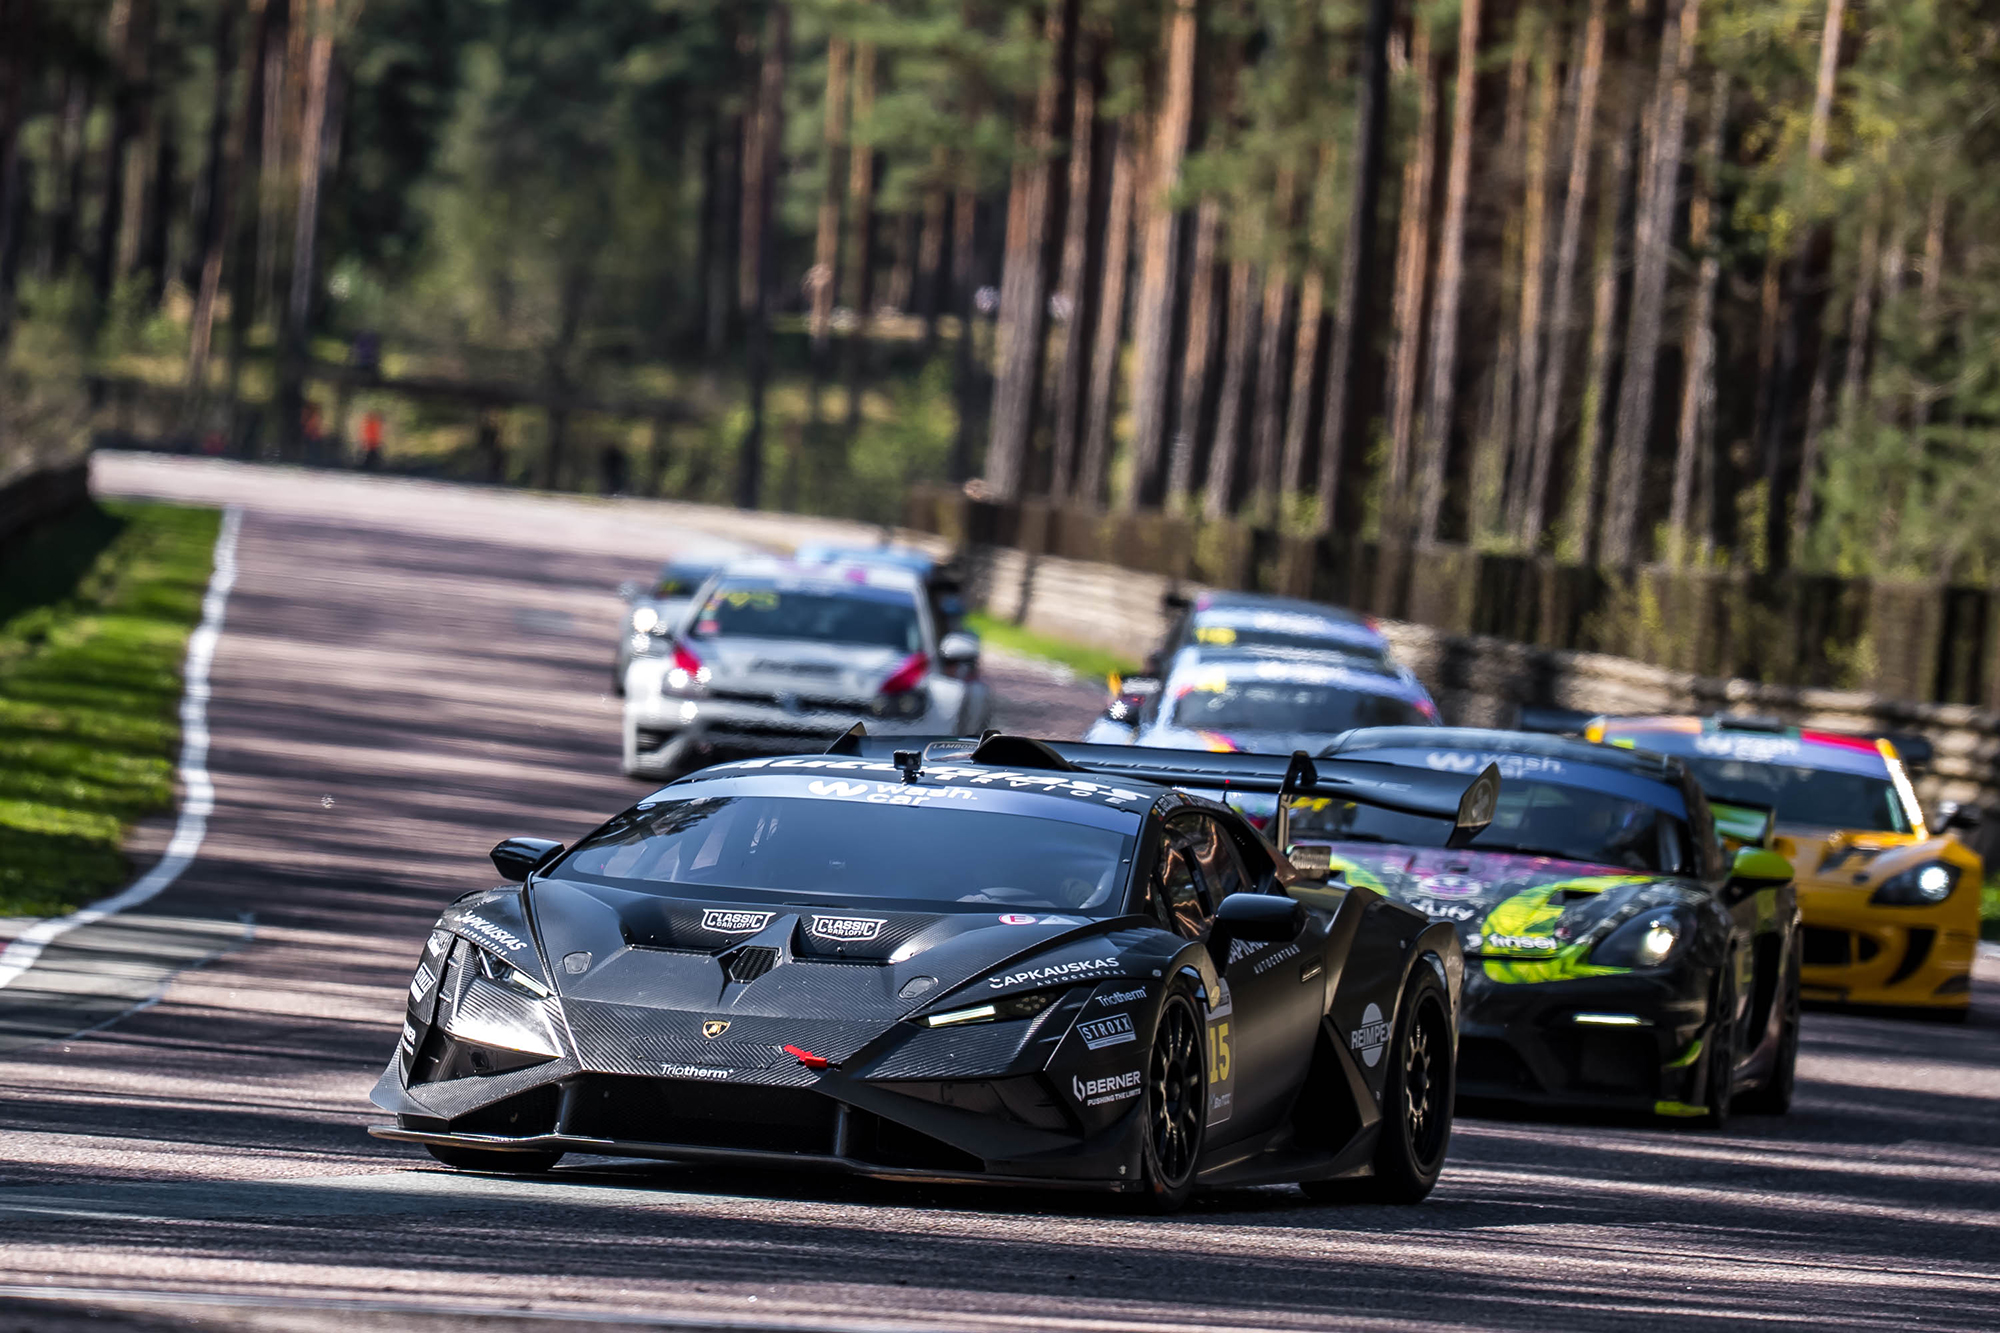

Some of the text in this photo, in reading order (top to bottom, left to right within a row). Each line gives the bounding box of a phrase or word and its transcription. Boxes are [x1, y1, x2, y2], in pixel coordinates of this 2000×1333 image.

[866, 793, 931, 806] car
[706, 912, 764, 929] CLASSIC
[817, 919, 875, 936] CLASSIC
[1036, 970, 1127, 987] AUTOCENTRAS
[1082, 1017, 1131, 1040] STROXX
[1351, 1021, 1393, 1050] REIMPEX
[1209, 1022, 1230, 1084] 15
[1086, 1070, 1141, 1095] BERNER
